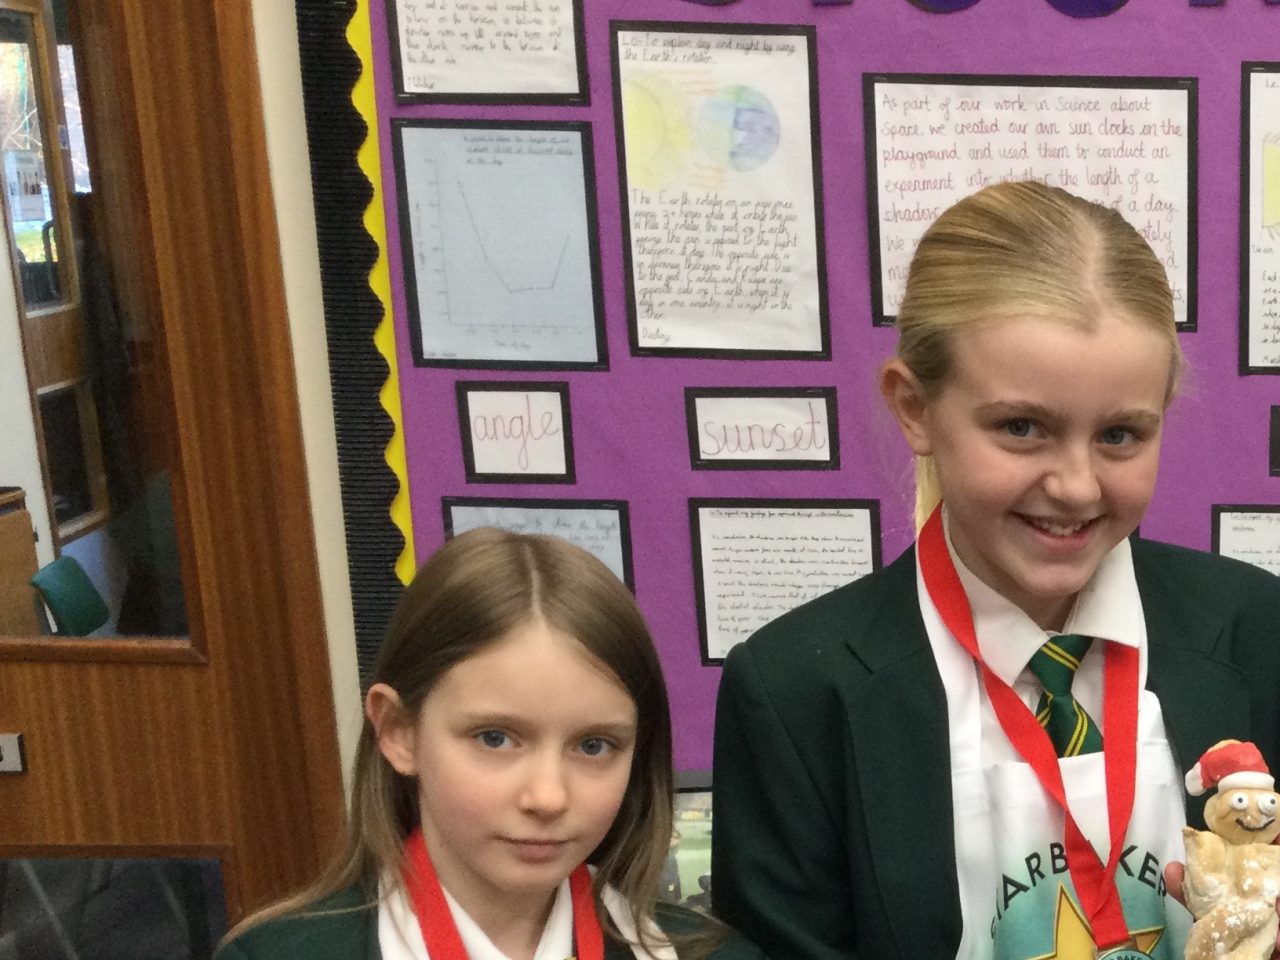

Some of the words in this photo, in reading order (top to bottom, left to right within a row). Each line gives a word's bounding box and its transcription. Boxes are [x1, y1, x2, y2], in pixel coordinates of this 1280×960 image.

[883, 94, 898, 111] As
[904, 95, 931, 116] part
[940, 97, 951, 121] of
[956, 99, 981, 111] our
[995, 94, 1027, 111] work
[1035, 98, 1050, 111] in
[1056, 96, 1101, 112] Science
[1110, 96, 1152, 112] about
[930, 122, 946, 136] we
[955, 117, 1000, 135] created
[1008, 121, 1030, 134] our
[1035, 121, 1060, 135] own
[1069, 121, 1093, 136] sun
[1098, 117, 1135, 136] clocks
[1139, 123, 1158, 136] on
[1160, 118, 1182, 136] the
[882, 143, 962, 169] playground
[968, 142, 995, 160] and
[999, 141, 1029, 160] used
[1037, 141, 1071, 159] them
[1076, 142, 1090, 160] to
[1097, 140, 1147, 159] conduct
[1151, 145, 1171, 159] an
[884, 172, 955, 199] experiment
[967, 168, 993, 187] into
[1059, 168, 1078, 186] the
[1086, 165, 1123, 196] length
[1128, 167, 1141, 194] of
[1145, 172, 1160, 184] a
[1128, 200, 1139, 213] a
[473, 394, 560, 471] angle
[700, 401, 827, 456] sunset
